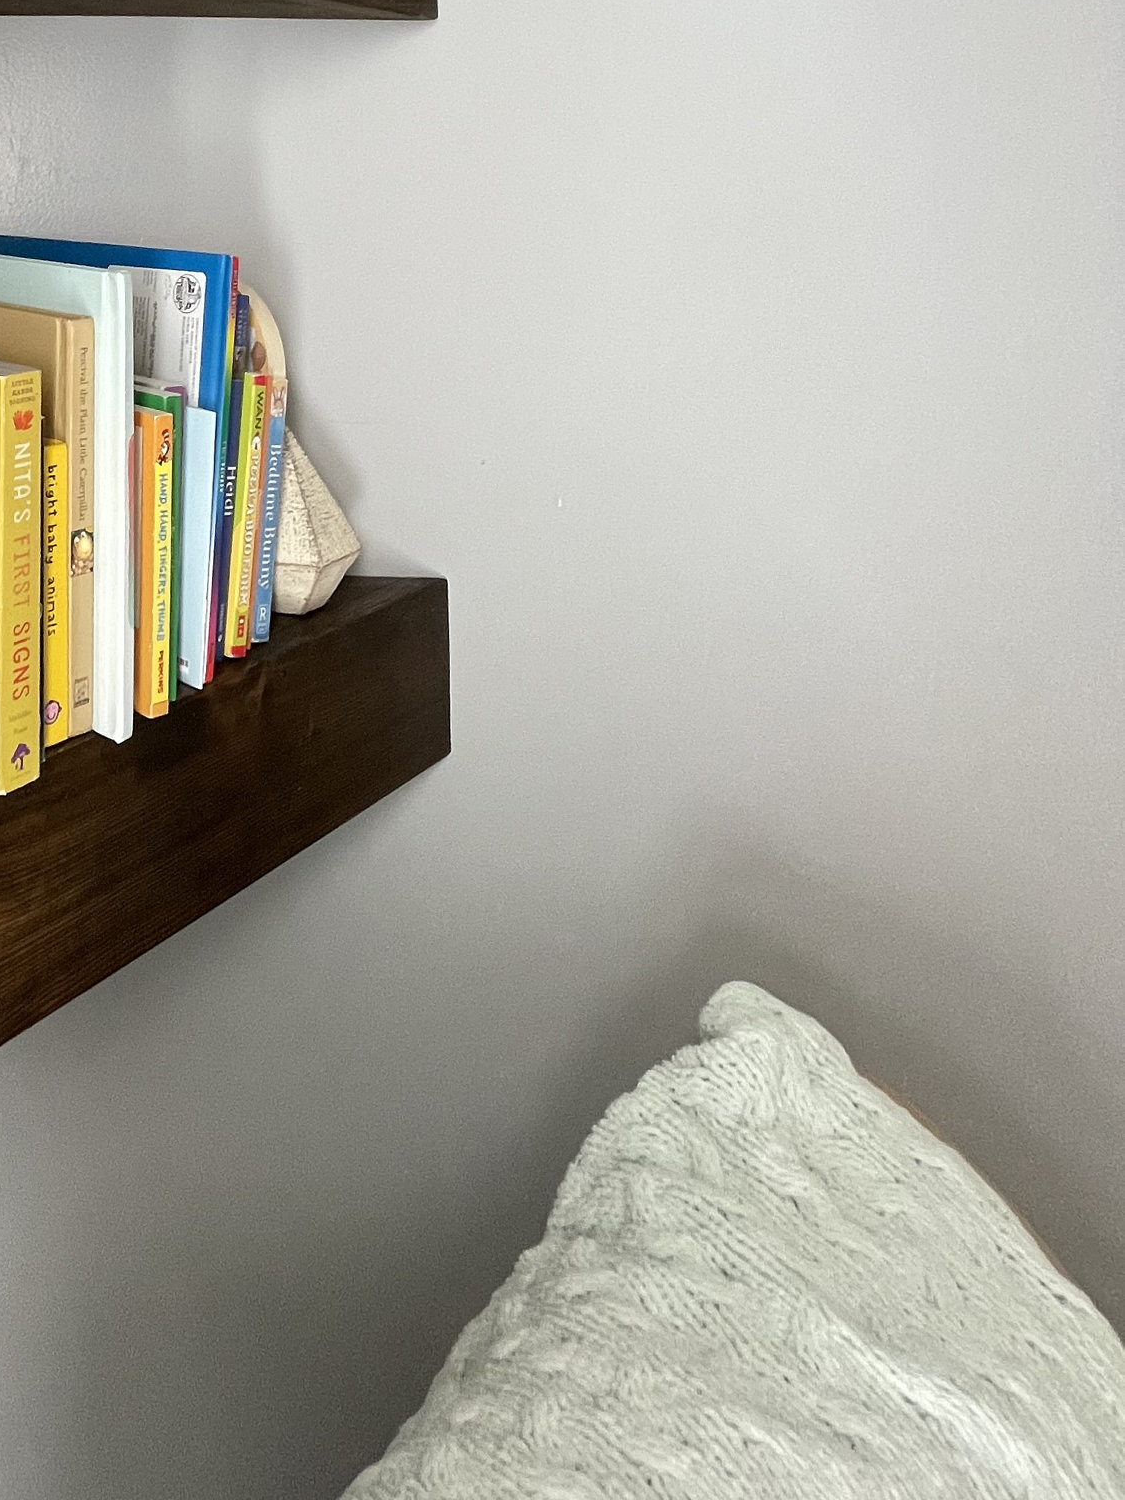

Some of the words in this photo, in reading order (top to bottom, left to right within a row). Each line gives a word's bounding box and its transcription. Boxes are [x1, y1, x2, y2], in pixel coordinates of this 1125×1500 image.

[79, 347, 89, 385] Percival
[79, 389, 89, 406] the
[79, 409, 88, 435] Plain
[254, 391, 264, 429] WAN
[79, 437, 88, 465] Little
[13, 442, 32, 524] NITA'S
[45, 464, 58, 517] bright
[77, 467, 88, 521] Caterpillar
[224, 466, 237, 516] Heidi
[264, 444, 282, 522] Bedtime
[45, 524, 58, 565] baby
[259, 527, 276, 590] Bunny
[13, 533, 31, 607] FIRST
[46, 577, 58, 637] animals
[156, 600, 166, 642] THUMB
[12, 621, 31, 701] SIGNS
[157, 650, 165, 694] PERKINS
